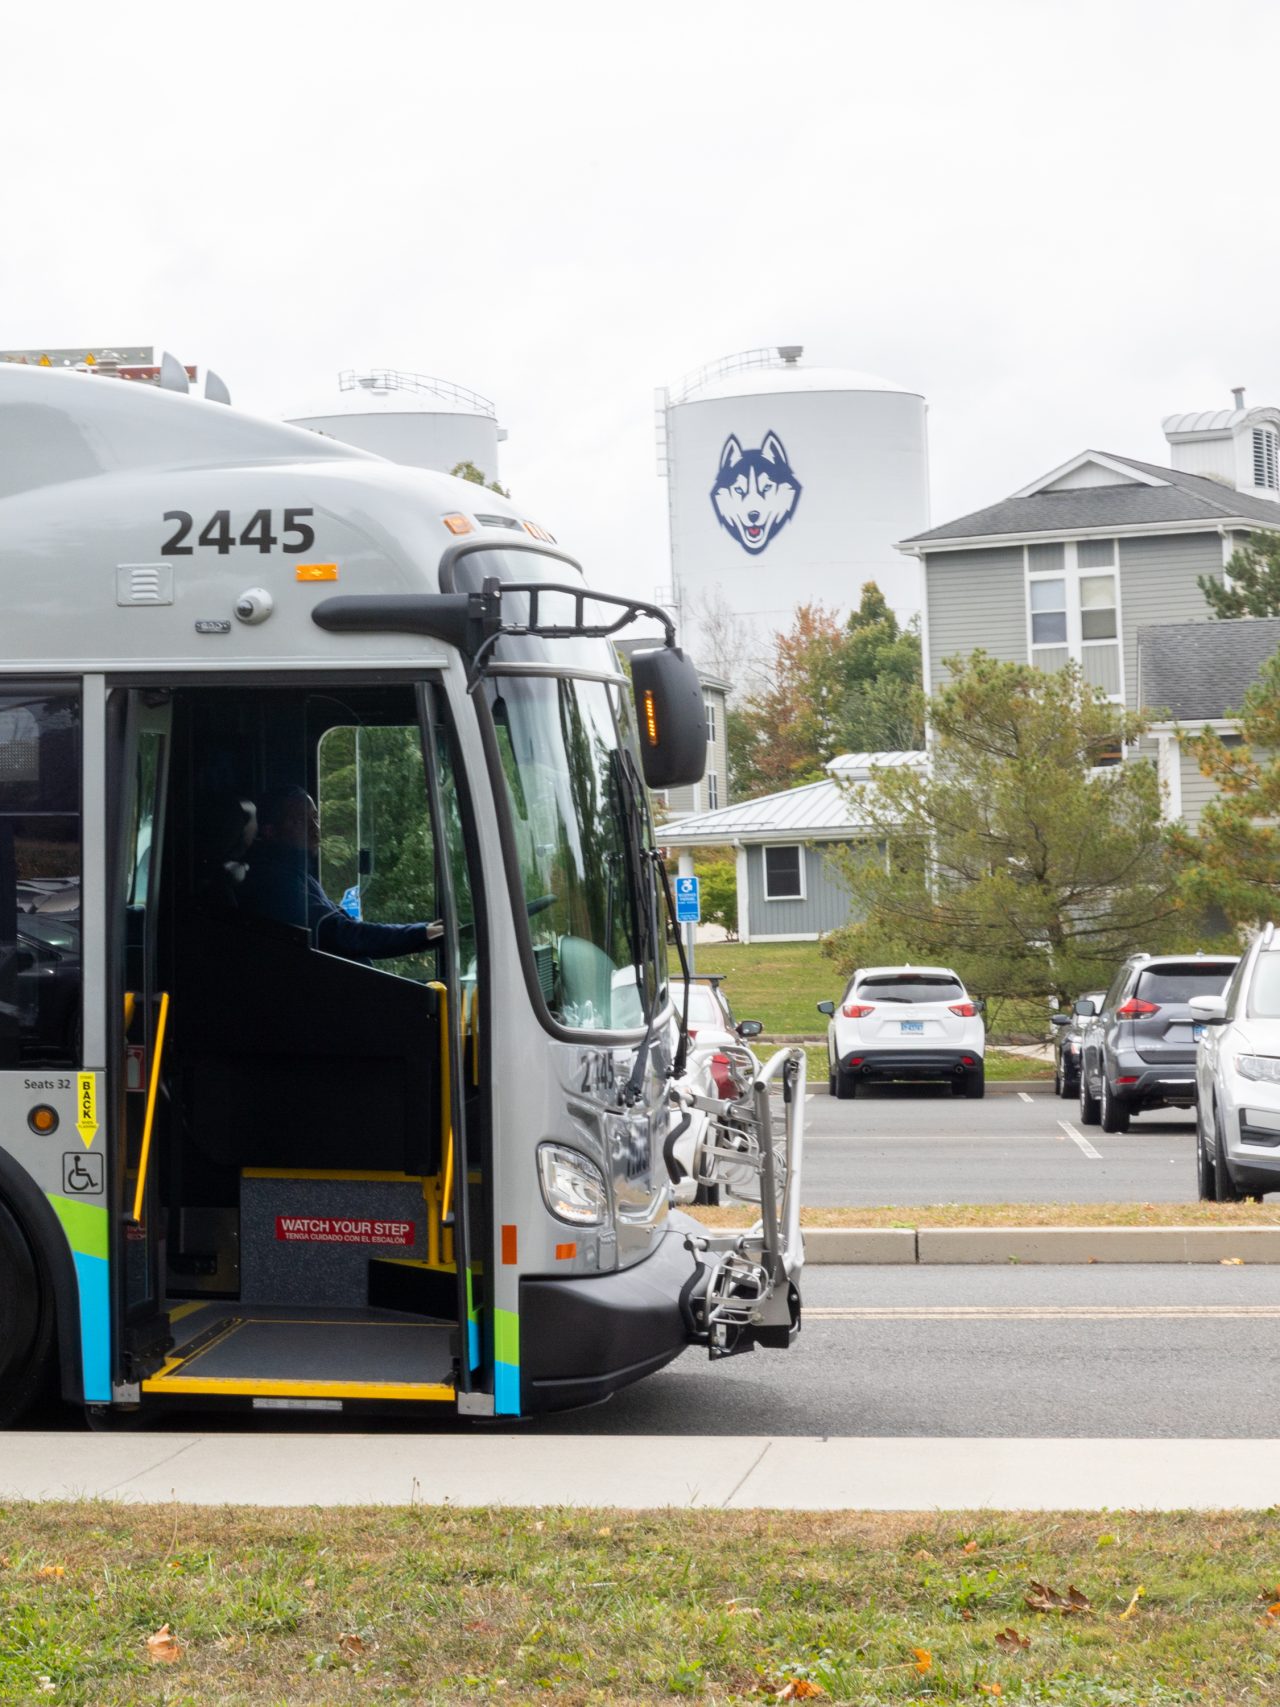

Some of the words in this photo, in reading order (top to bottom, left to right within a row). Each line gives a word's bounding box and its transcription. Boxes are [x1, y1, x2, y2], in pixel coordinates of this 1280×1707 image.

[161, 508, 315, 555] 2445
[23, 1079, 55, 1090] Seats
[57, 1079, 71, 1090] 32
[82, 1081, 92, 1119] BACK
[281, 1219, 330, 1232] WATCH
[332, 1220, 372, 1235] YOUR
[374, 1222, 410, 1236] STEP
[285, 1232, 309, 1240] TENGA
[310, 1233, 344, 1242] CUIDADO
[361, 1235, 371, 1243] EL
